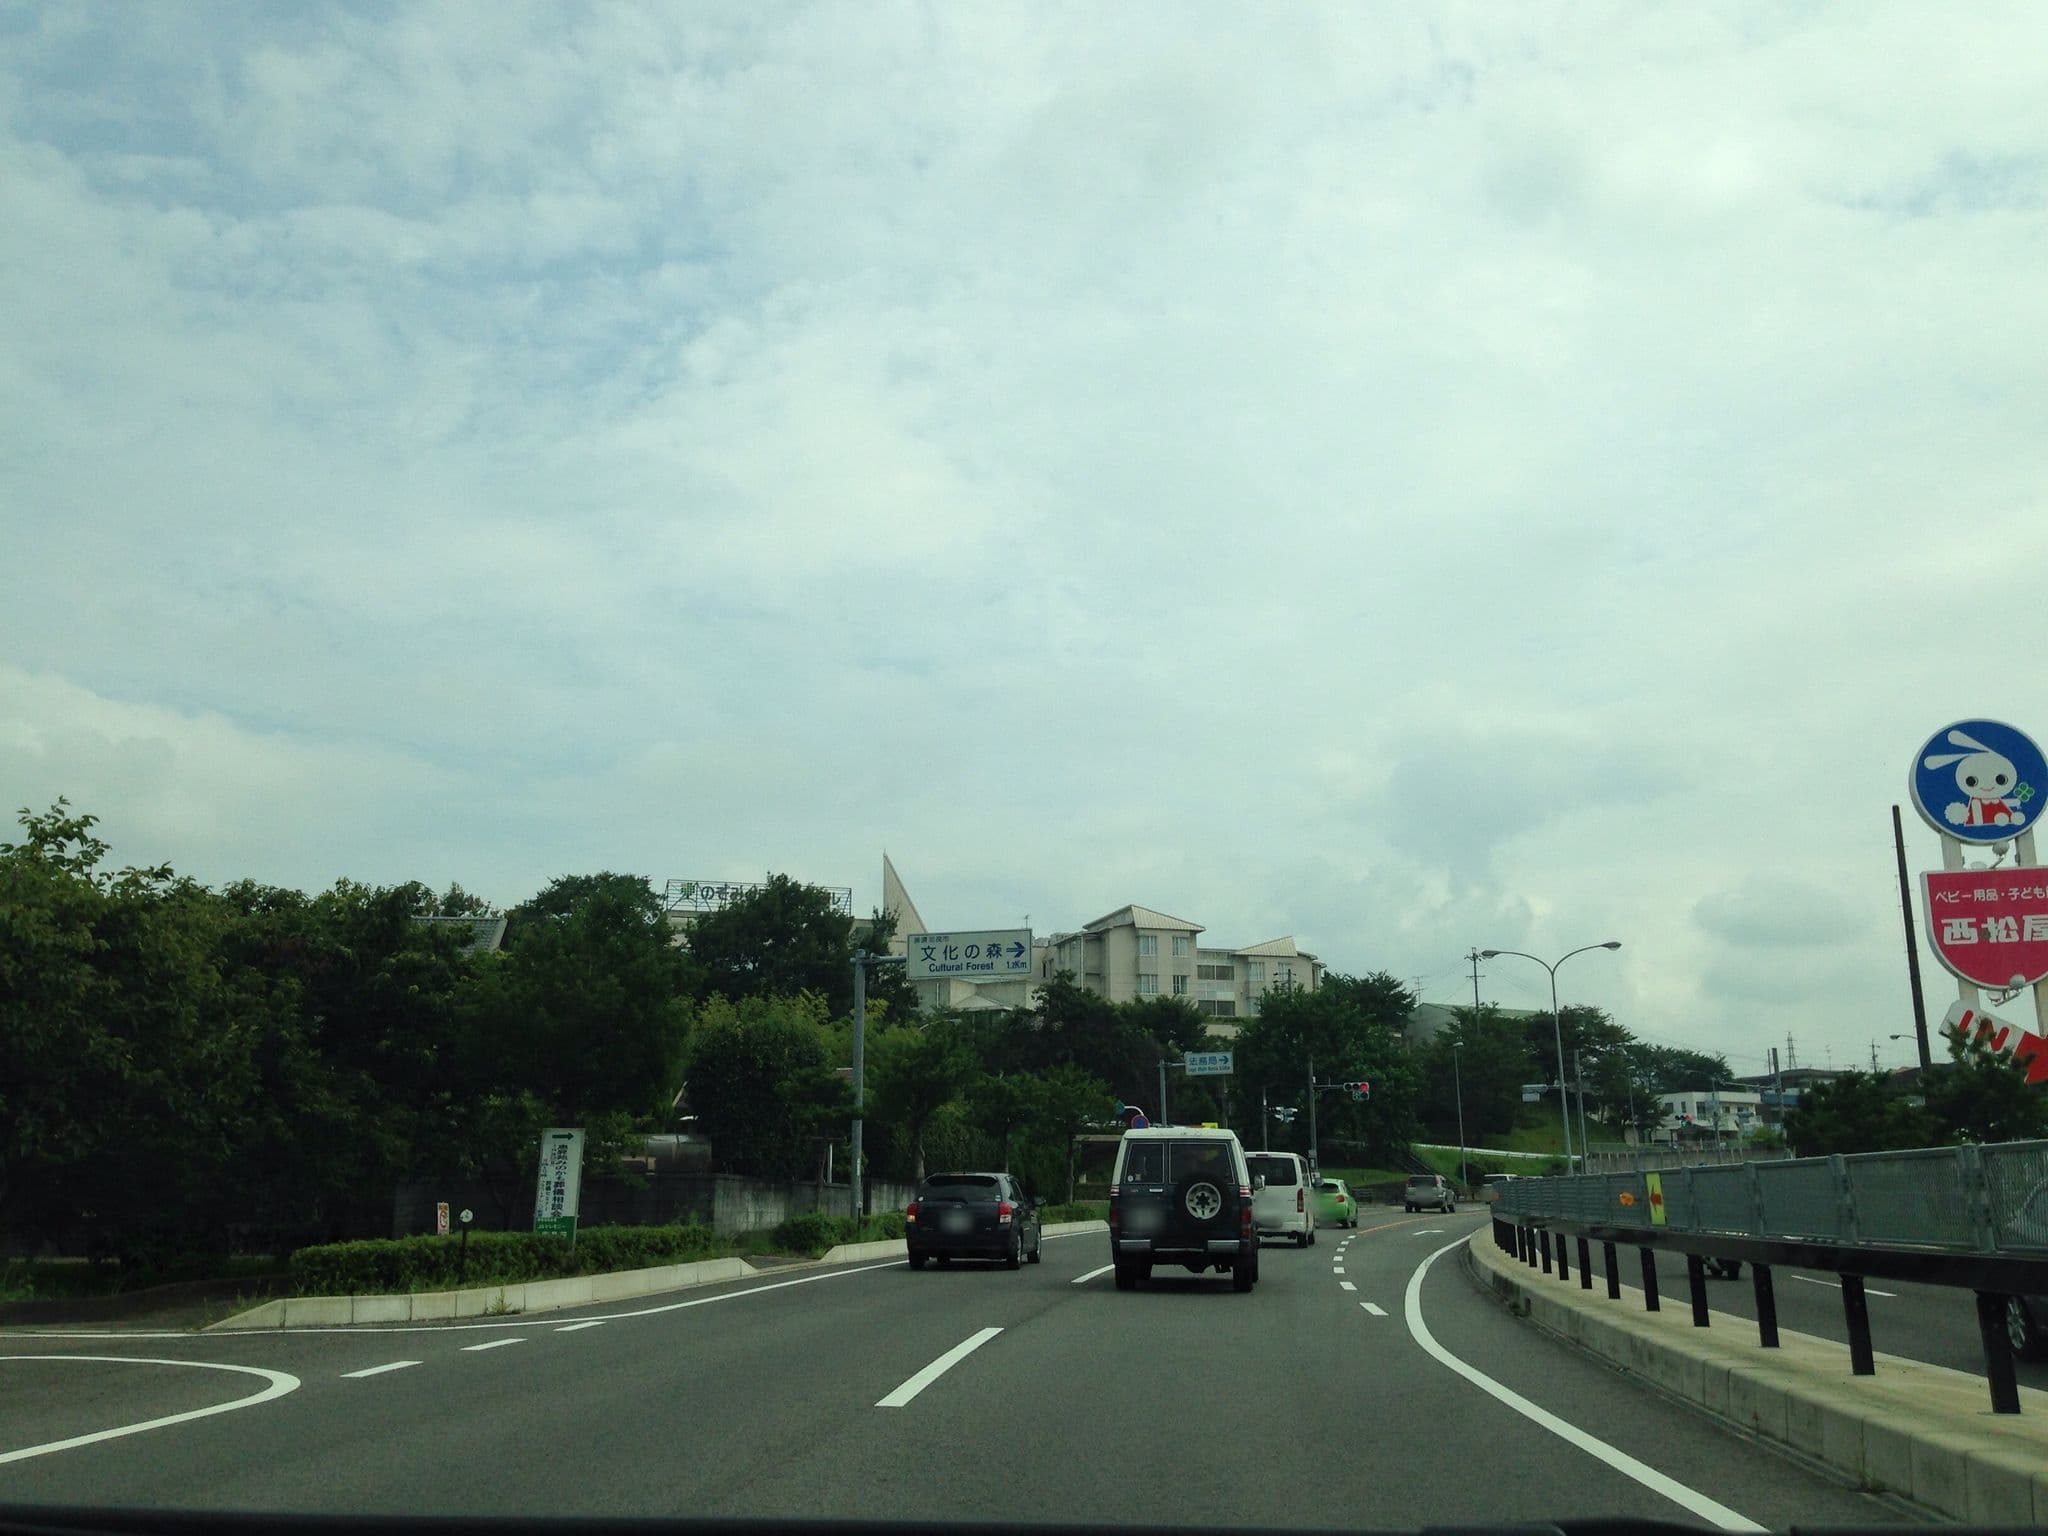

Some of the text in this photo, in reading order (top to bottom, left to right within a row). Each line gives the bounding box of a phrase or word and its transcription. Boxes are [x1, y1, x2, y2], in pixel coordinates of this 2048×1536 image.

[1935, 885, 2048, 903] ベビー用品・子ども
[1941, 914, 2048, 945] 西松屋
[921, 942, 1002, 961] 文化の森
[928, 963, 963, 972] Cultural
[966, 961, 994, 971] Forest
